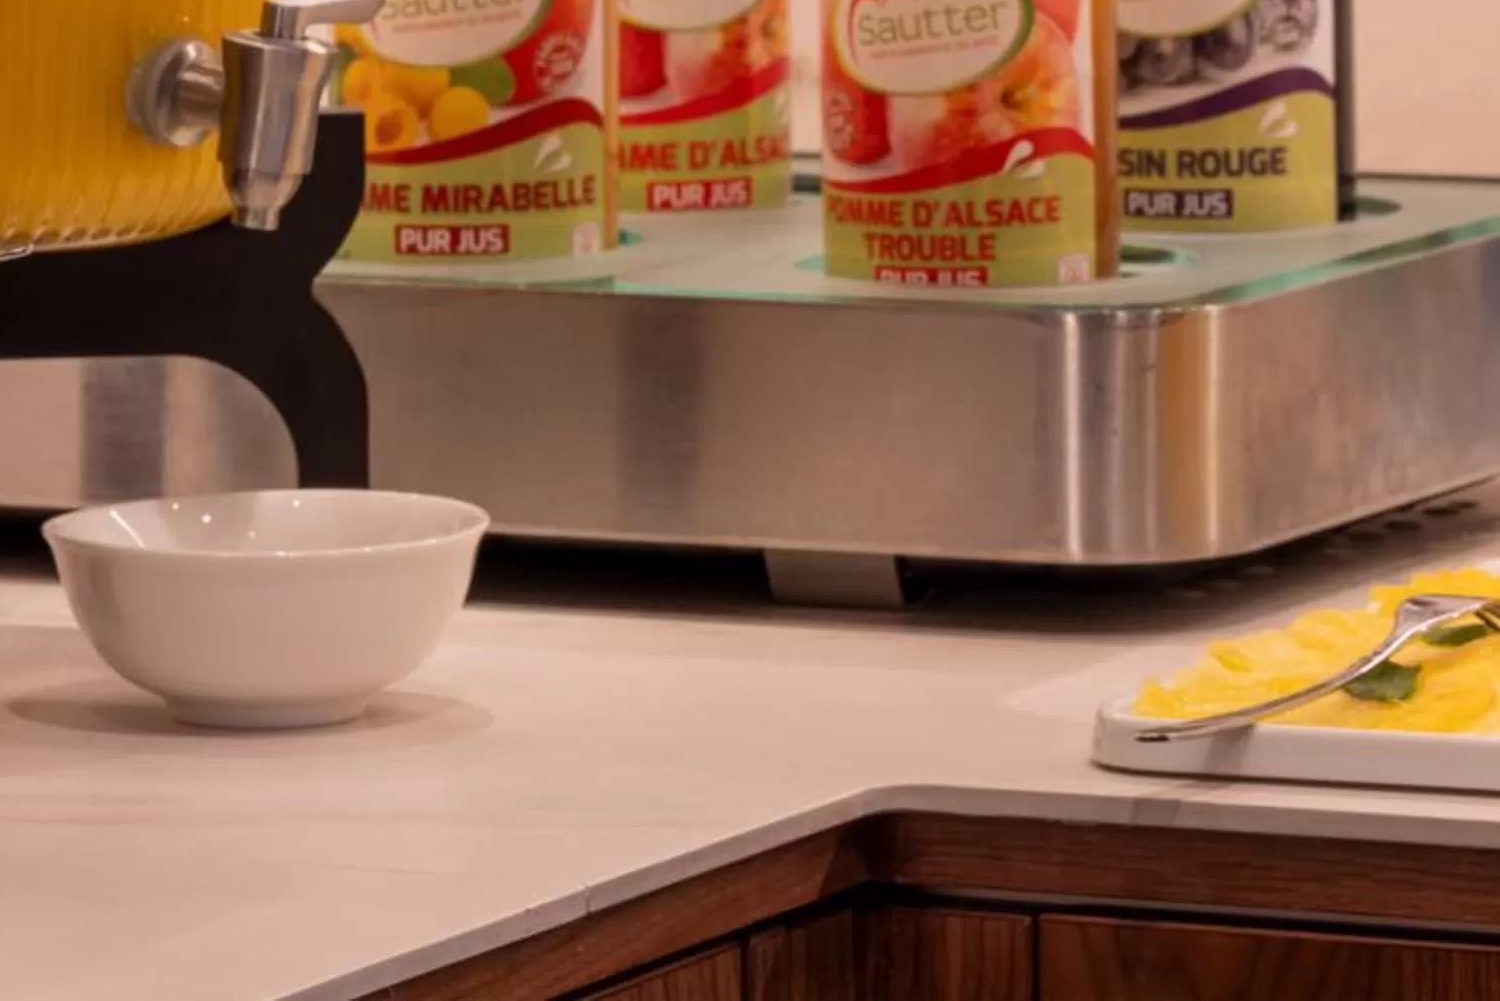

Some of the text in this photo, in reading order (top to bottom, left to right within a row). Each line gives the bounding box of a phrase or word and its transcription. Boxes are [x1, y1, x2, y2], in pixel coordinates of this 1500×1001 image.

[1176, 146, 1289, 178] ROUGE
[421, 174, 597, 214] MIRABELLE
[652, 178, 749, 208] PUR JUS
[1128, 189, 1228, 216] PUR JUS
[912, 196, 1062, 228] D'ALSACE
[401, 227, 504, 253] PUR JUS
[862, 233, 998, 263] TROUBLE
